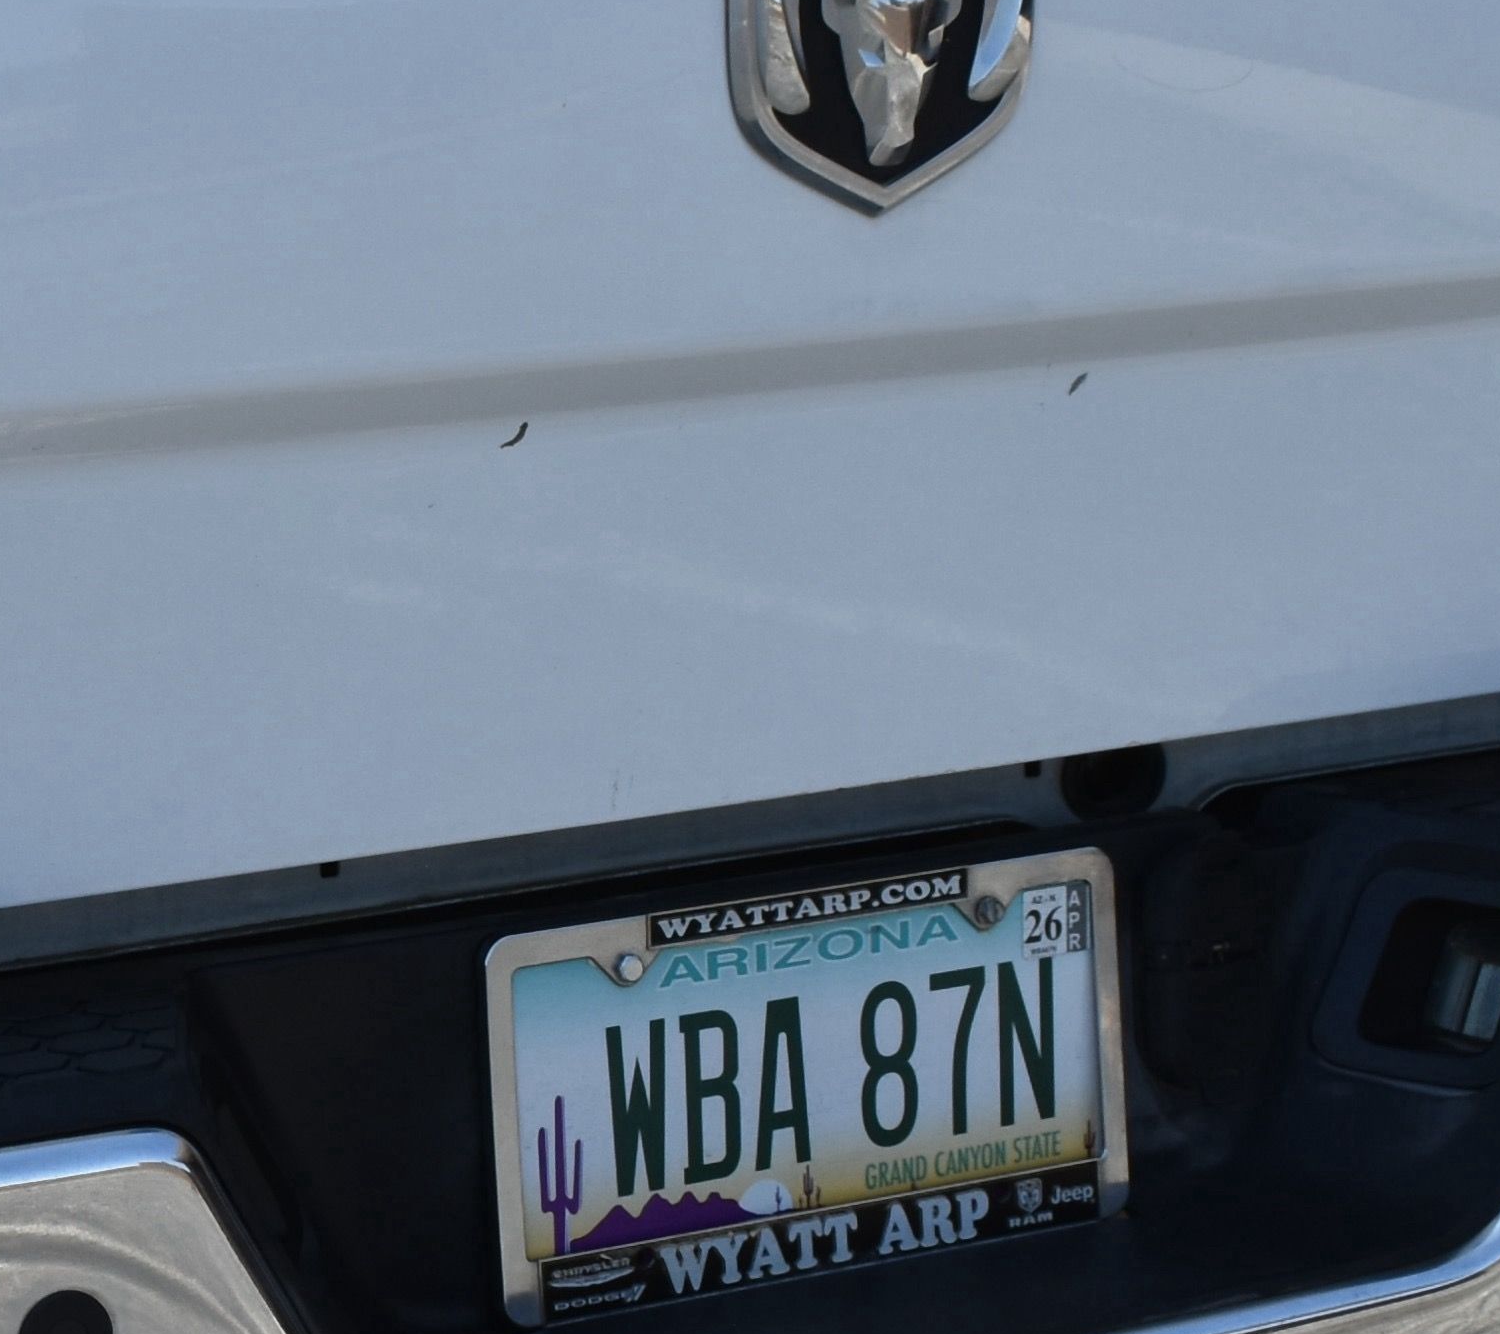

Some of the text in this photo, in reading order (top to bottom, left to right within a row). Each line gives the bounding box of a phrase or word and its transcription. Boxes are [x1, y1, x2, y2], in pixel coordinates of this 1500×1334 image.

[658, 874, 963, 940] WYATTARP.COM
[1024, 906, 1062, 944] 26
[658, 914, 959, 989] ARIZONA
[605, 957, 1057, 1198] WBA 87N
[865, 1130, 1062, 1190] GRAND CANYON STATE
[1009, 1212, 1054, 1228] RAM
[1051, 1184, 1095, 1205] Jeep
[658, 1189, 990, 1295] WYATT ARP
